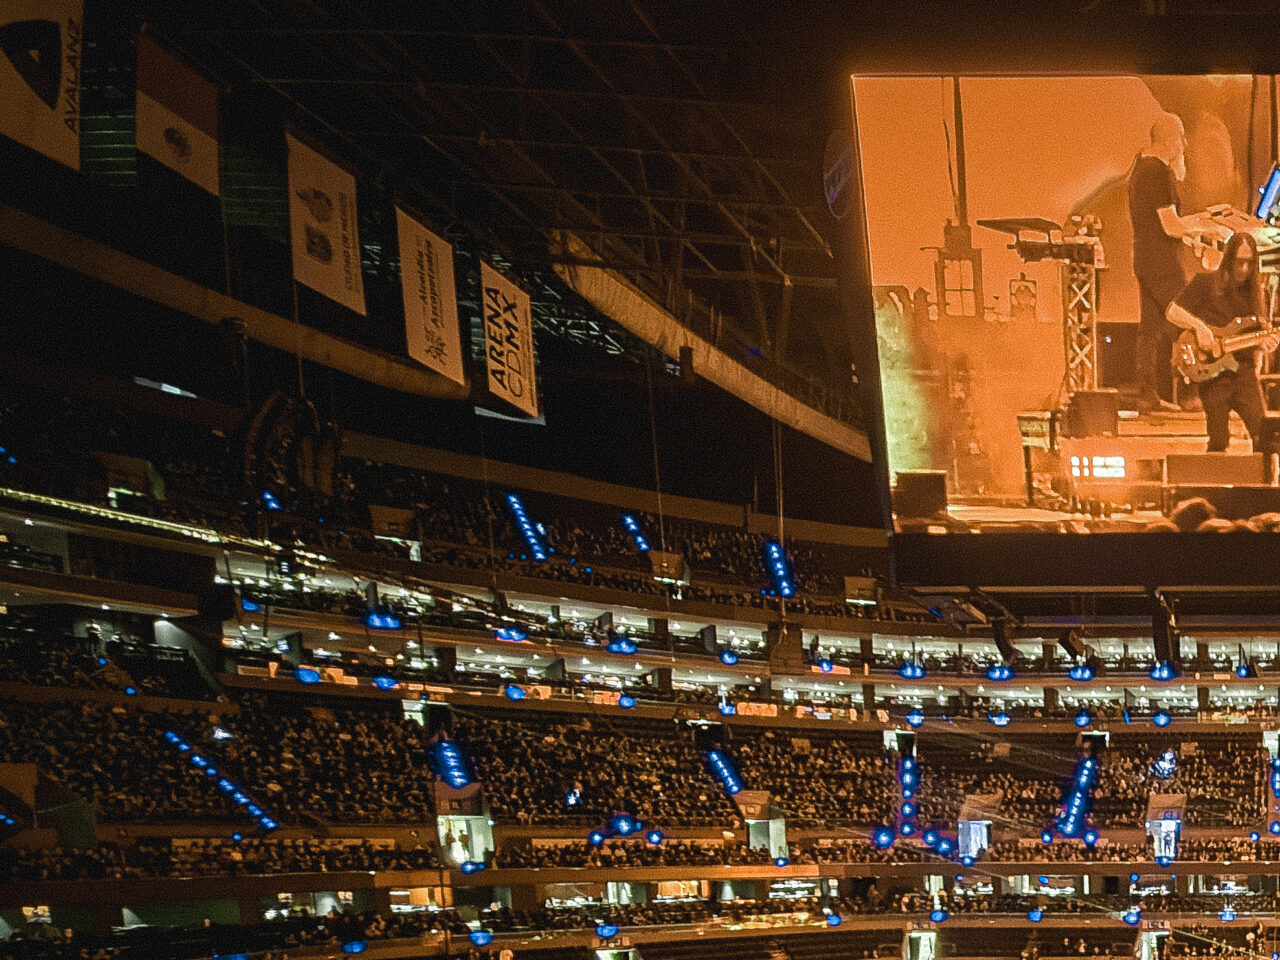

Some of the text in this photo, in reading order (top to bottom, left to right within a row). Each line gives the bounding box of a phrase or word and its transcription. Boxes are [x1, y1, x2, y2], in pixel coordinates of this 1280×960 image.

[64, 18, 81, 134] AVALANZ
[486, 287, 507, 390] ARENA
[501, 294, 523, 398] CDMX
